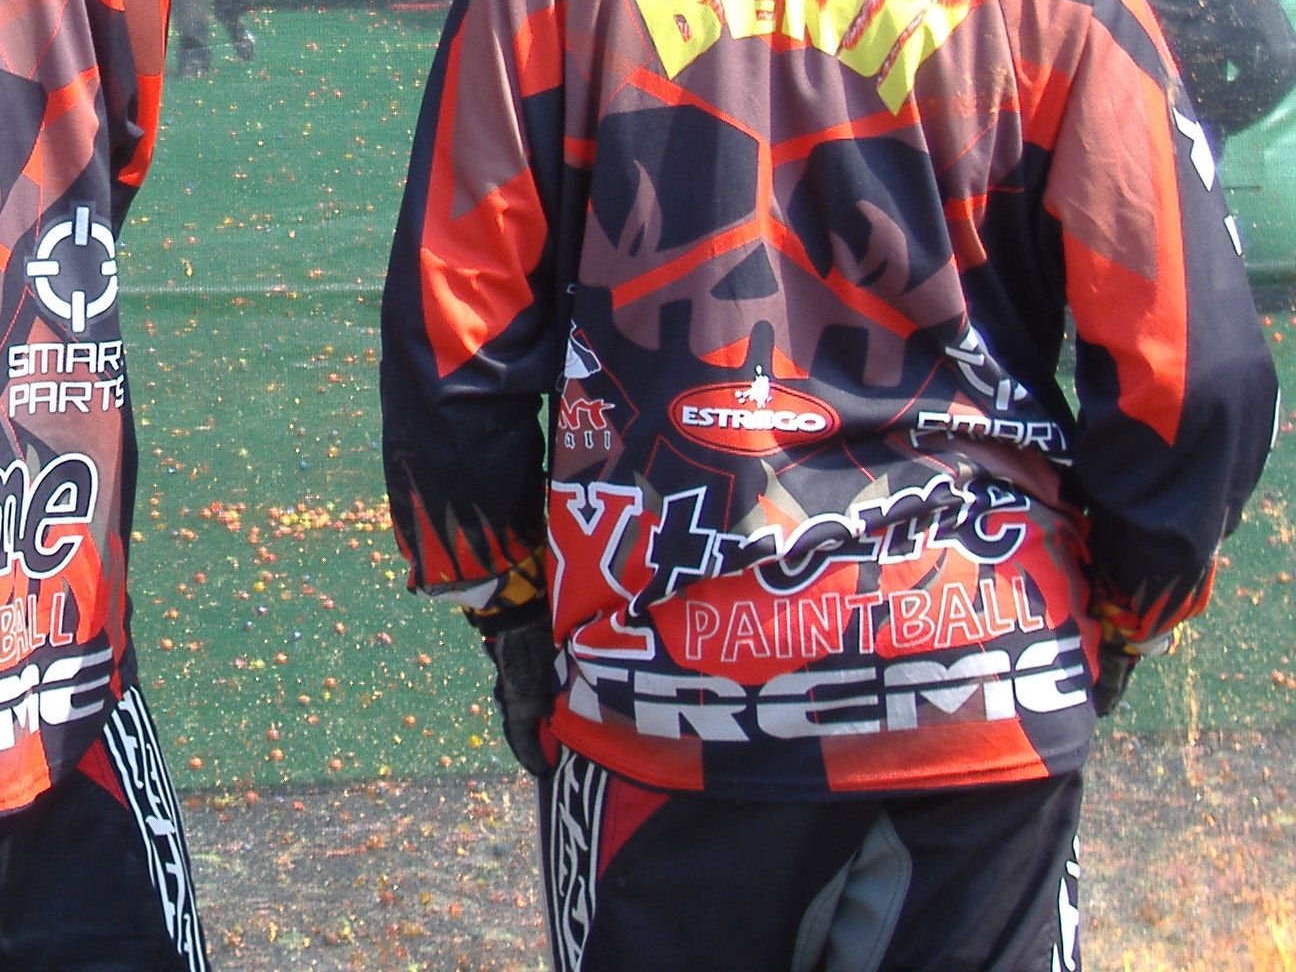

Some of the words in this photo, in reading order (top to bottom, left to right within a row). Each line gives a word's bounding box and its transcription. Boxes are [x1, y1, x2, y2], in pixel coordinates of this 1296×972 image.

[8, 340, 124, 378] SMAR
[685, 577, 1045, 662] PAINTBALL
[554, 636, 1088, 743] TREME
